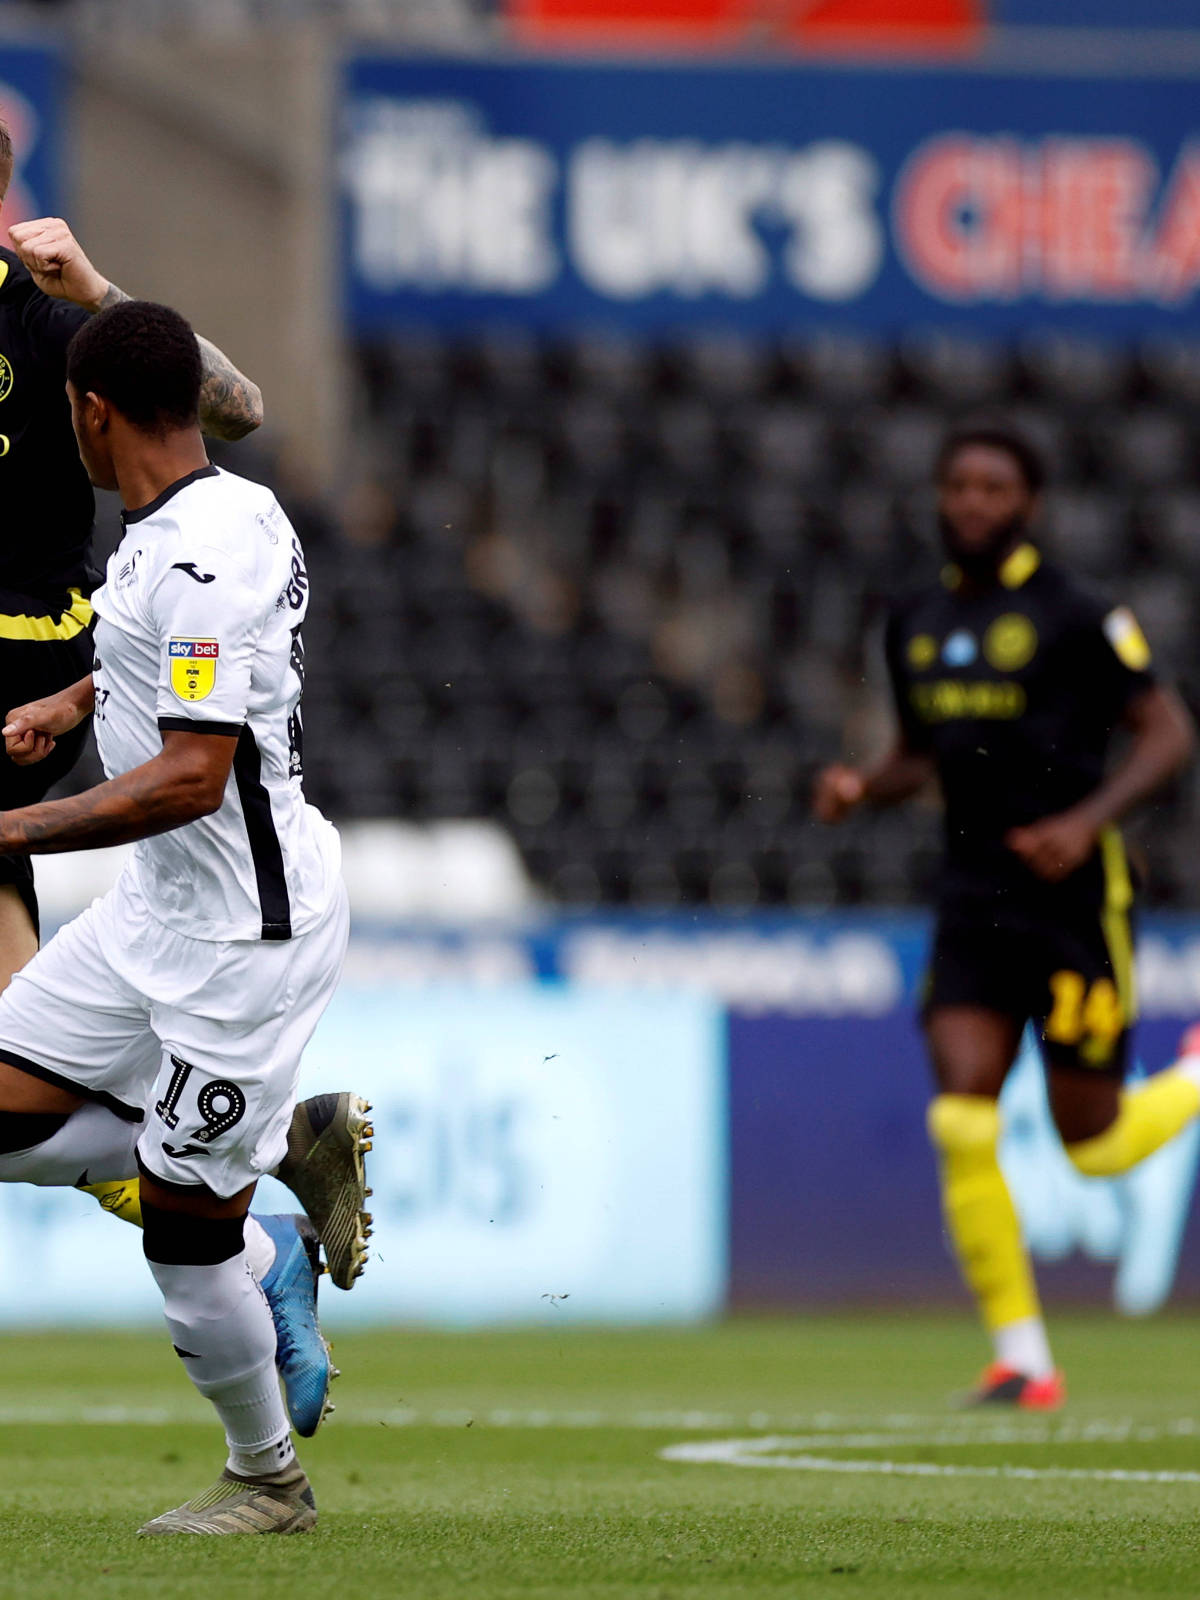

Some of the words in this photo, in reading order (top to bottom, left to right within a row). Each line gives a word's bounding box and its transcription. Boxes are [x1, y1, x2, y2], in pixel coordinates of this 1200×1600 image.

[346, 98, 556, 294] THE
[568, 138, 883, 300] UK'S
[170, 643, 191, 656] sky
[195, 643, 217, 655] bet
[1047, 969, 1122, 1046] 14
[155, 1054, 246, 1143] 19
